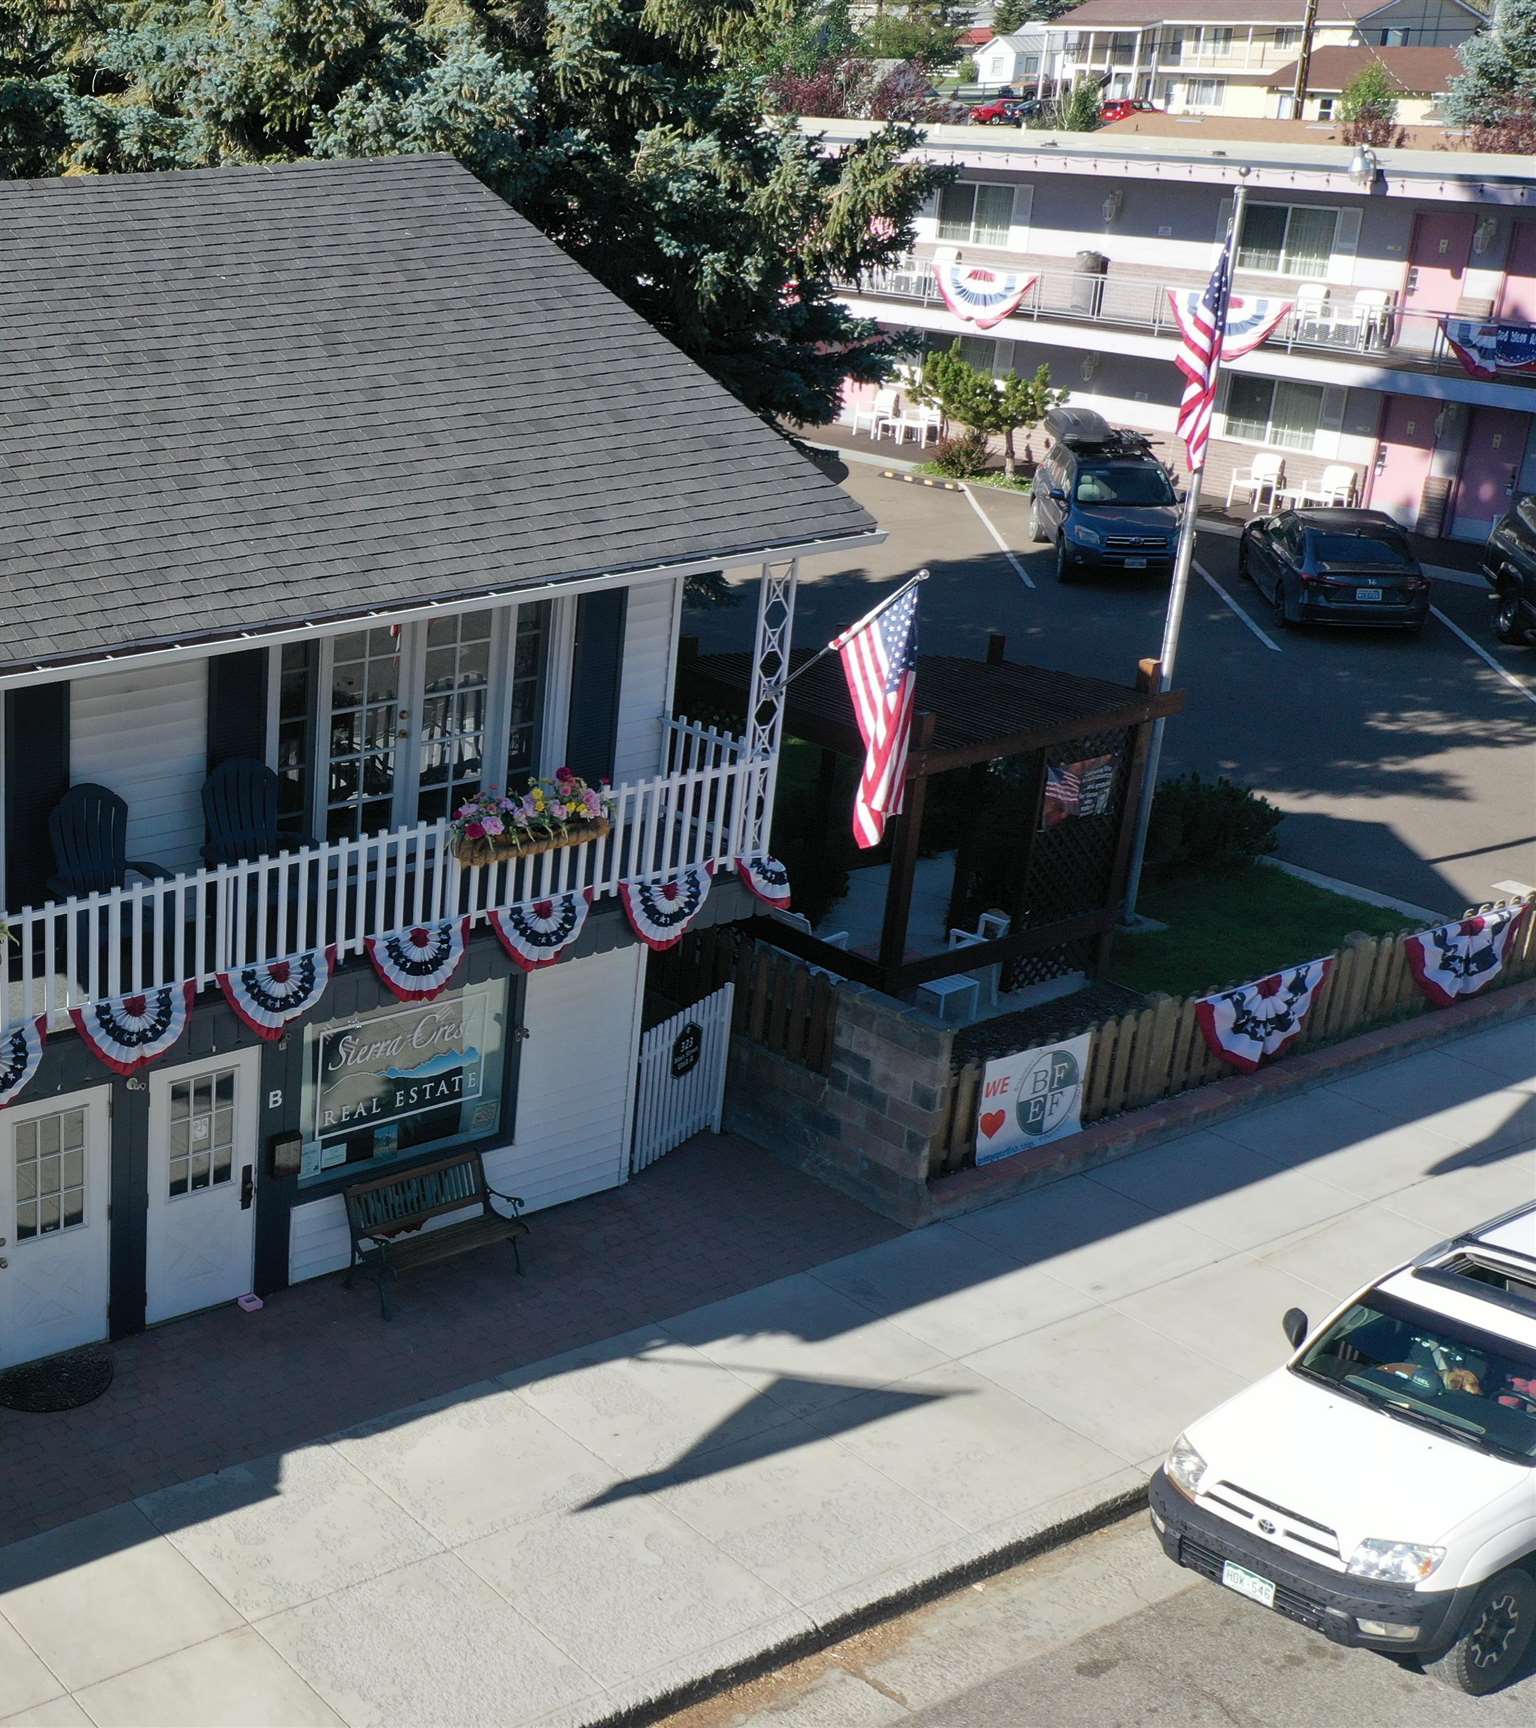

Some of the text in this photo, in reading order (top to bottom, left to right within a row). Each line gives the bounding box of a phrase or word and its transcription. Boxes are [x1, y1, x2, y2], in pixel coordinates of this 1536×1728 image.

[328, 1035, 402, 1071] Sierra
[268, 1089, 283, 1109] B
[324, 1072, 476, 1127] REAL ESTATE
[984, 1076, 1010, 1098] WE
